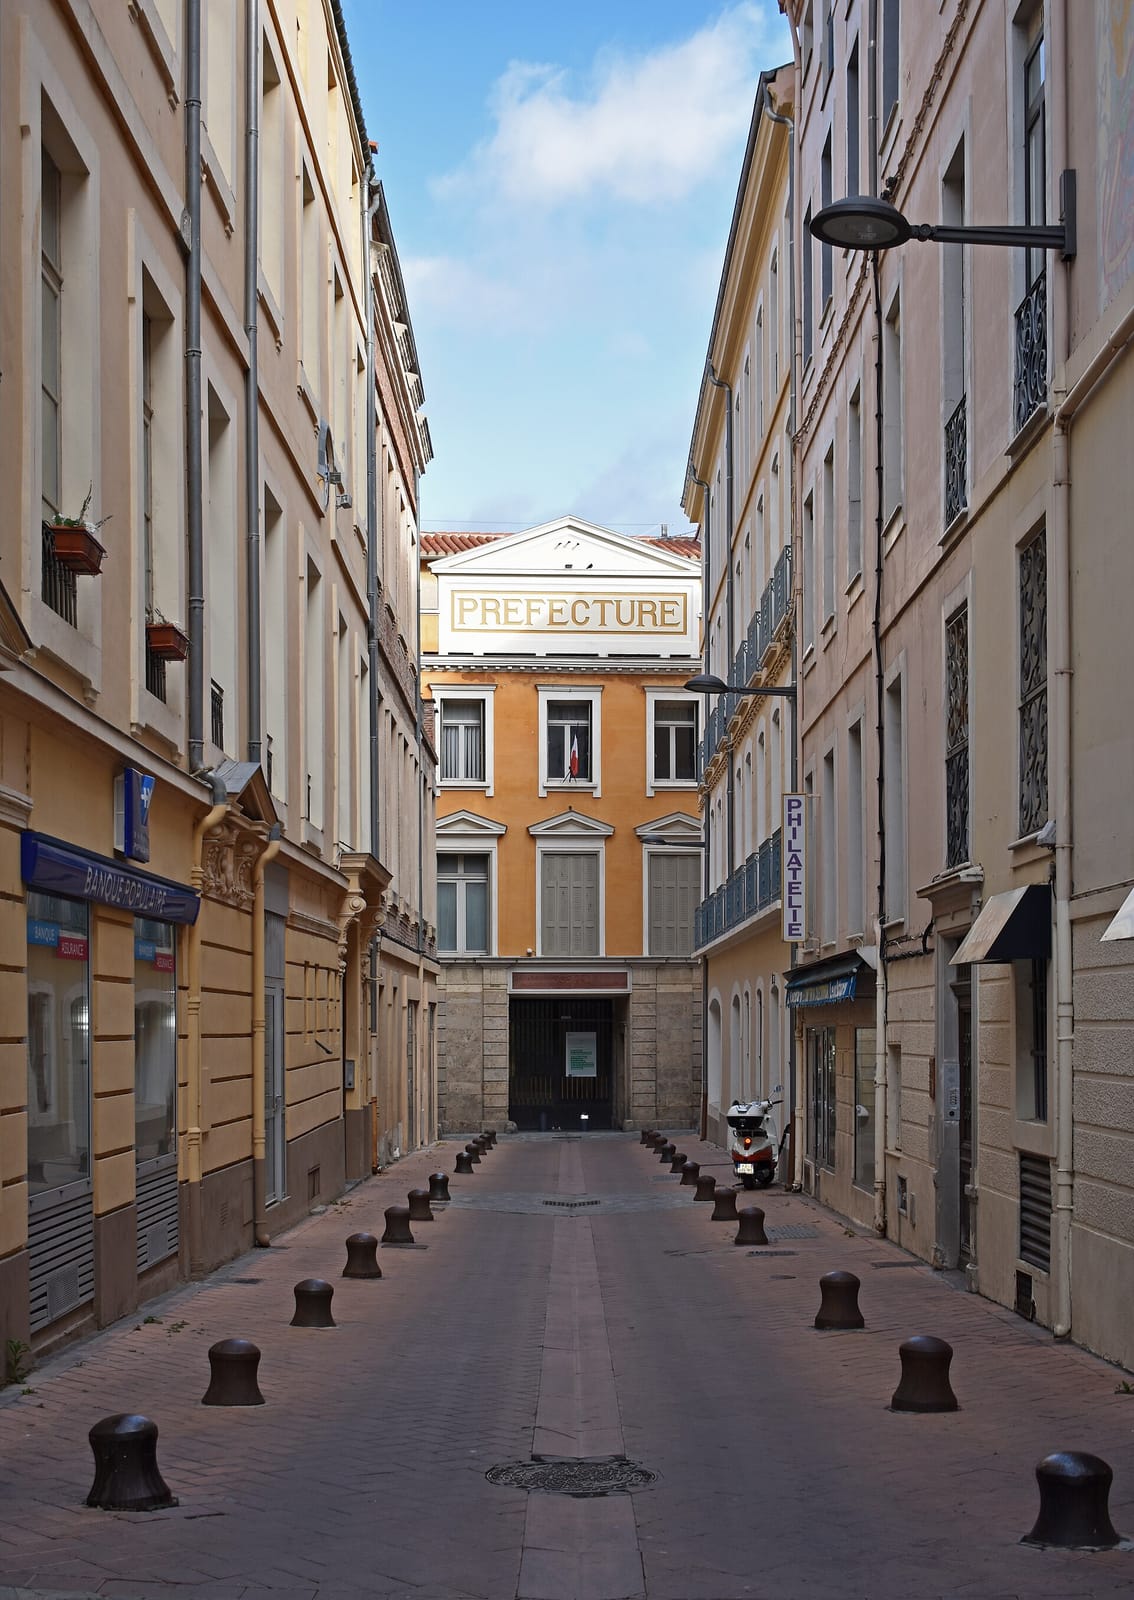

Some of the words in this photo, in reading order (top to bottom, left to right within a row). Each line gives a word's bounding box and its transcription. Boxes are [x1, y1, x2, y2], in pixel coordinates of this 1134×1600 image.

[457, 598, 681, 628] PREFECTURE
[787, 798, 802, 937] PHILATELIE
[84, 866, 124, 903] BANQUE
[123, 879, 167, 914] POPULAIRE
[34, 926, 56, 942] BANQUE
